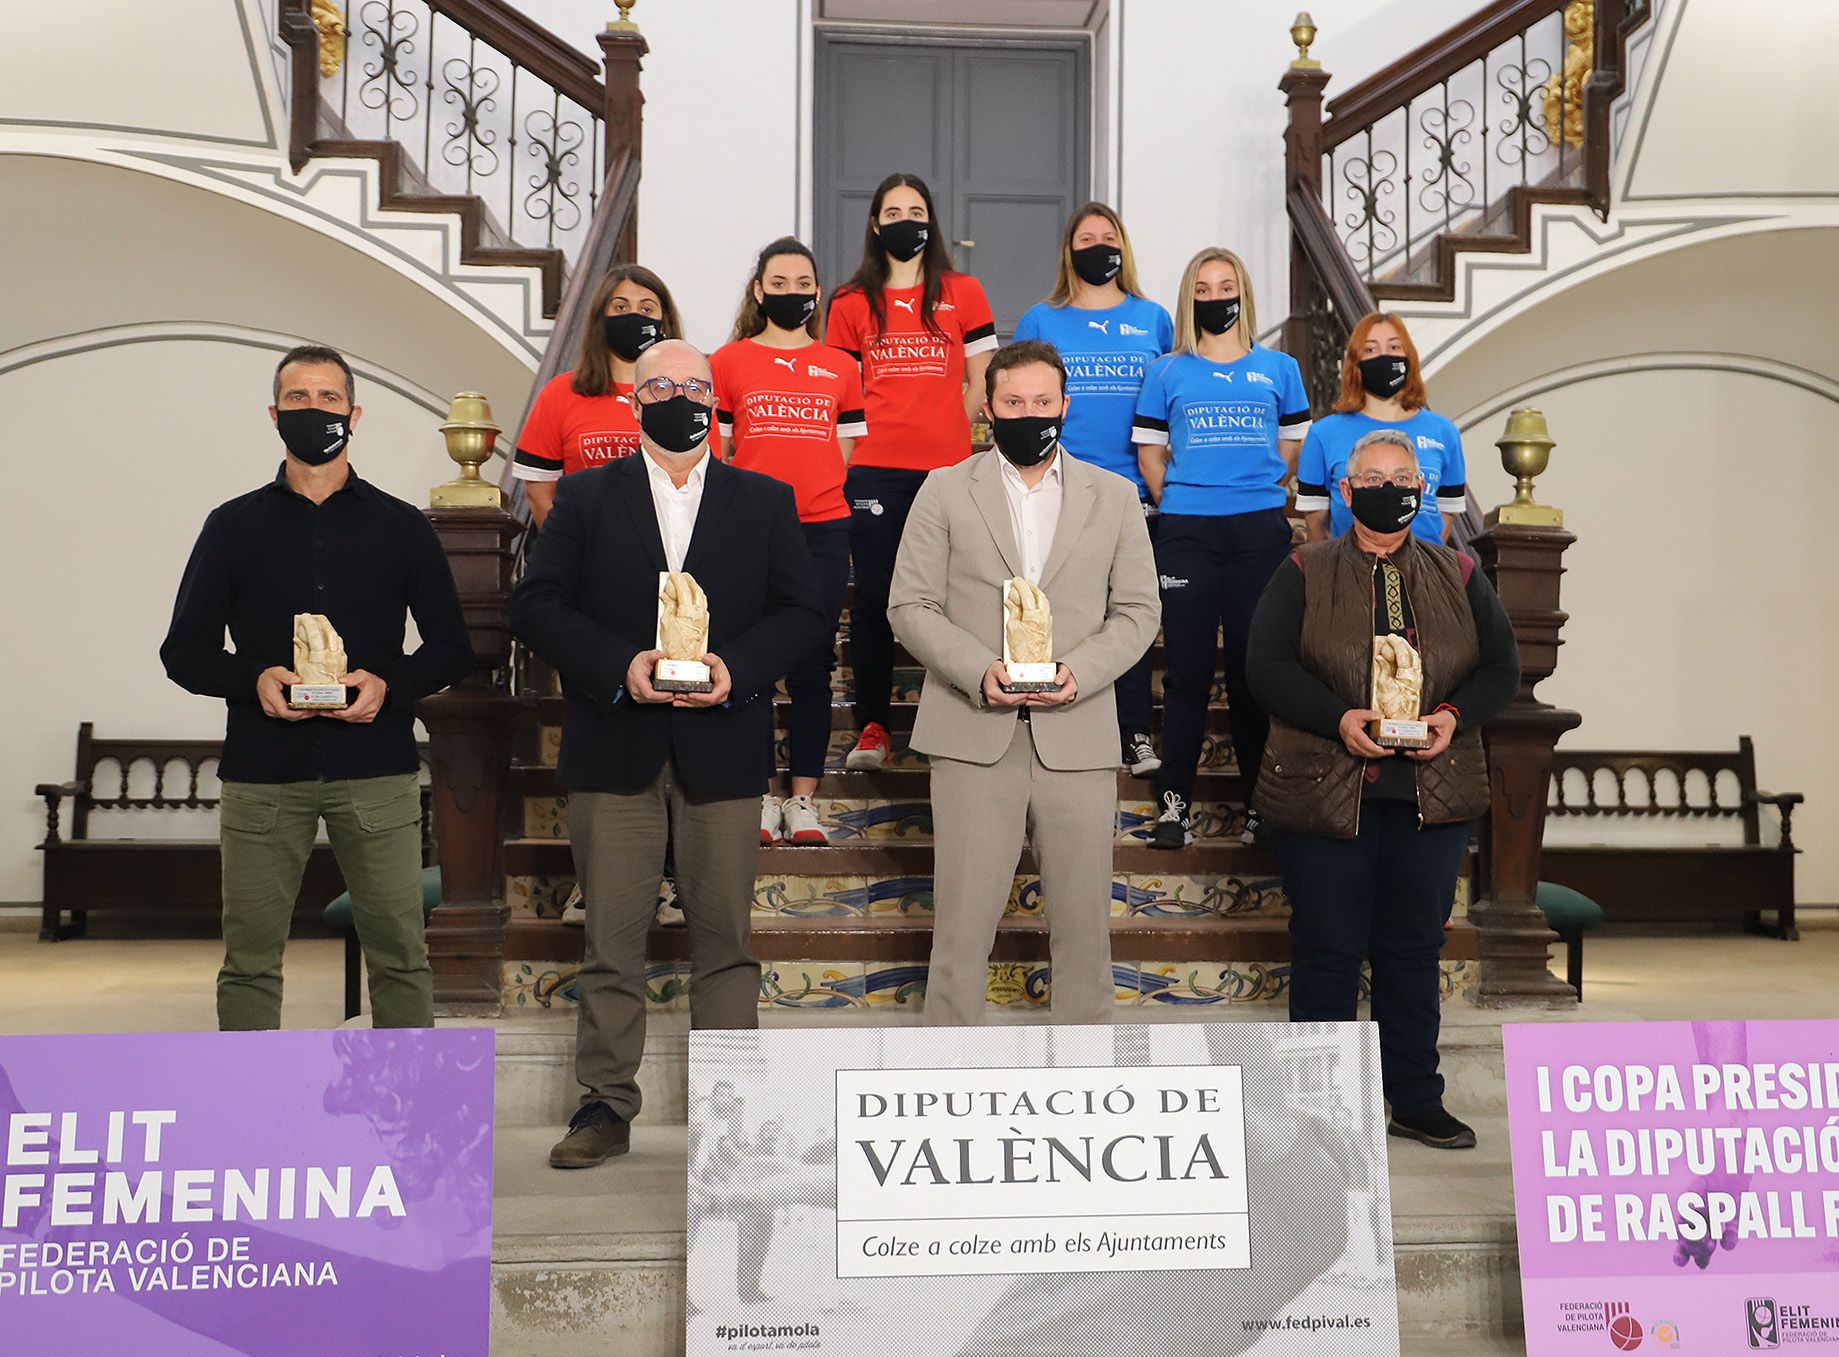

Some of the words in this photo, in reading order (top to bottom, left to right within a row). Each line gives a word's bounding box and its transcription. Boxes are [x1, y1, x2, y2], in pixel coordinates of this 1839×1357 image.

[870, 345, 946, 360] VALÈNCIA
[1062, 355, 1126, 364] DIPUTACIÓ
[1064, 362, 1144, 378] VALÈNCIA
[746, 395, 811, 405] DIPUTACIÓ
[815, 398, 830, 407] DE
[748, 404, 829, 422] VALÈNCIA
[1187, 405, 1250, 416] DIPUTACIÓ
[583, 436, 642, 446] DIPUTACI
[1537, 1066, 1551, 1112] I
[1562, 1065, 1686, 1112] COPA
[856, 1084, 1136, 1118] DIPUTACIÓ
[1158, 1088, 1221, 1114] DE
[7, 1110, 177, 1166] ELIT
[1541, 1130, 1599, 1177] LA
[1605, 1116, 1839, 1176] DIPUTACIÓ
[855, 1126, 1229, 1187] VALÈNCIA
[2, 1165, 407, 1227] FEMENINA
[1547, 1194, 1606, 1242] DE
[1615, 1191, 1816, 1242] RASPALL
[0, 1232, 193, 1268] FEDERACIÓ
[207, 1237, 250, 1262] DE
[862, 1235, 920, 1257] Colze
[928, 1241, 941, 1256] a
[949, 1234, 1002, 1255] colze
[1010, 1232, 1056, 1254] amb
[1065, 1231, 1091, 1253] els
[1096, 1231, 1227, 1258] Ajuntaments
[0, 1268, 116, 1296] PILOTA
[128, 1261, 339, 1292] VALENCIANA
[1559, 1301, 1603, 1311] FEDERACIÓ
[1780, 1305, 1810, 1317] ELIT
[1241, 1314, 1371, 1332] www.fedpival.es
[1565, 1313, 1576, 1321] DE
[1577, 1312, 1604, 1321] PILOTA
[716, 1322, 820, 1341] #pilotamola
[1557, 1322, 1605, 1332] VALENCIANA
